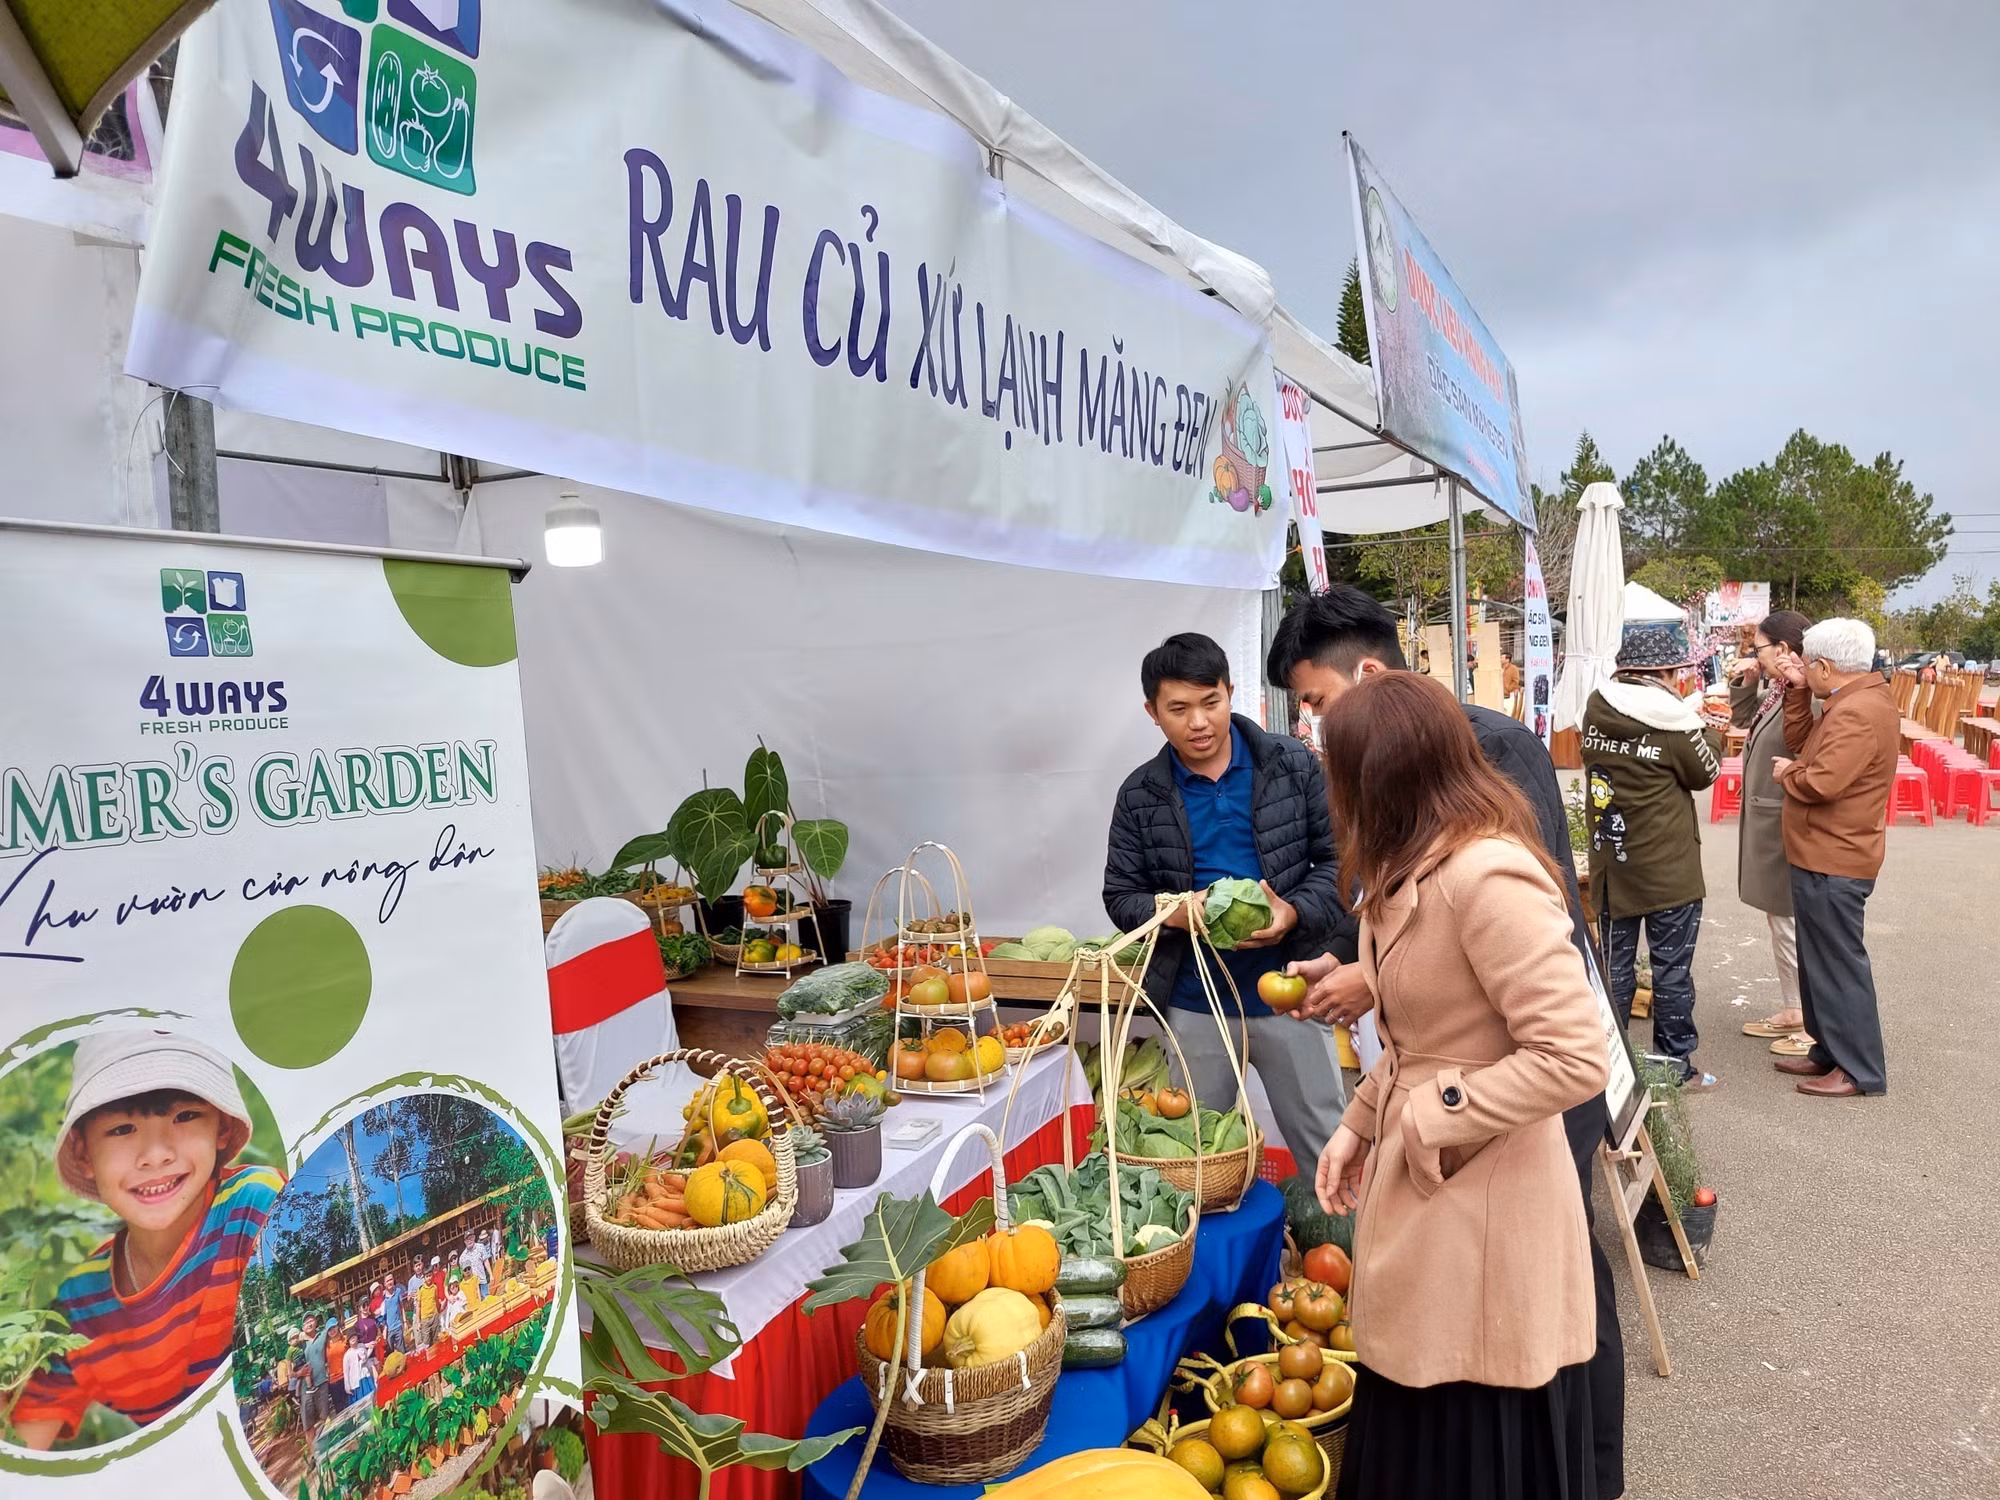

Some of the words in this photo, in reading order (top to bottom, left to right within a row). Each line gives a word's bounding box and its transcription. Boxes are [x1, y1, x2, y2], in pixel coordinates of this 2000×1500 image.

[208, 230, 340, 332] FRESH
[351, 302, 587, 392] PRODUCE
[623, 147, 780, 353] RAU
[803, 204, 890, 383] CỦ
[976, 301, 1064, 451] LẠNH
[1078, 334, 1167, 467] MĂNG
[1172, 384, 1218, 481] ĐEN
[139, 675, 288, 717] 4WAYS
[140, 721, 202, 736] FRESH
[209, 717, 289, 733] PRODUCE
[0, 746, 235, 850] MER'S
[251, 740, 497, 824] GARDEN
[1636, 744, 1662, 760] ME
[243, 872, 310, 901] của
[321, 860, 419, 924] nông
[429, 824, 495, 872] dân
